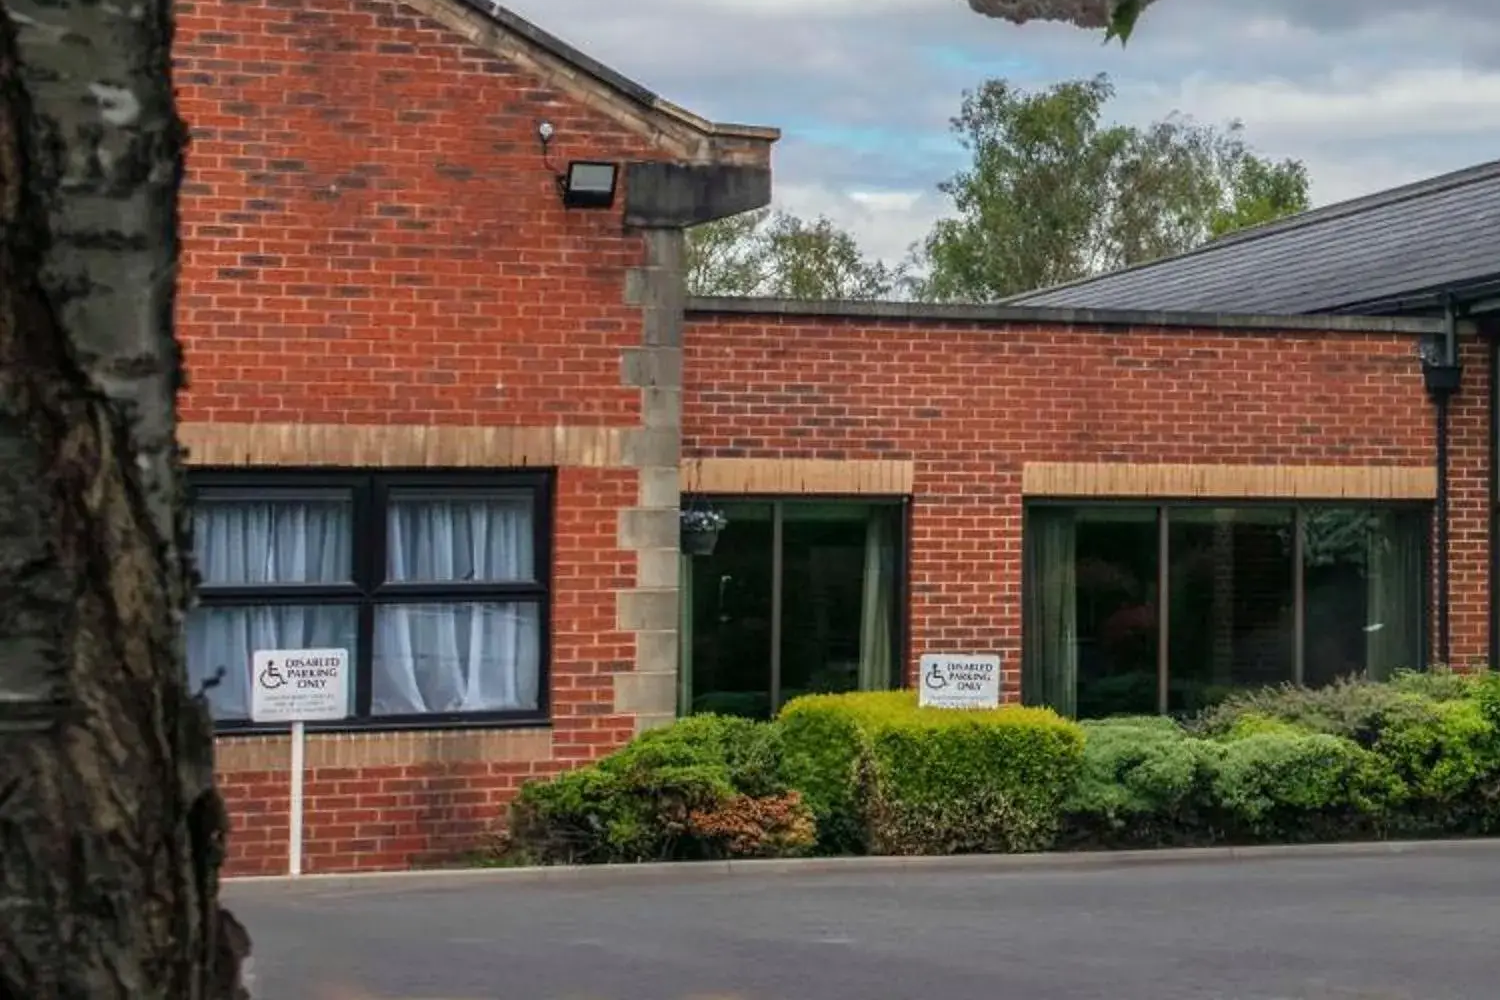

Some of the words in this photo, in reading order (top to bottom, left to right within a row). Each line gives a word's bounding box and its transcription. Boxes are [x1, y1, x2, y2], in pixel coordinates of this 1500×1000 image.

[285, 657, 340, 668] DISABLED
[287, 667, 337, 678] PARKING
[949, 672, 991, 681] PARKING
[297, 679, 326, 689] ONLY
[957, 681, 981, 690] ONLY
